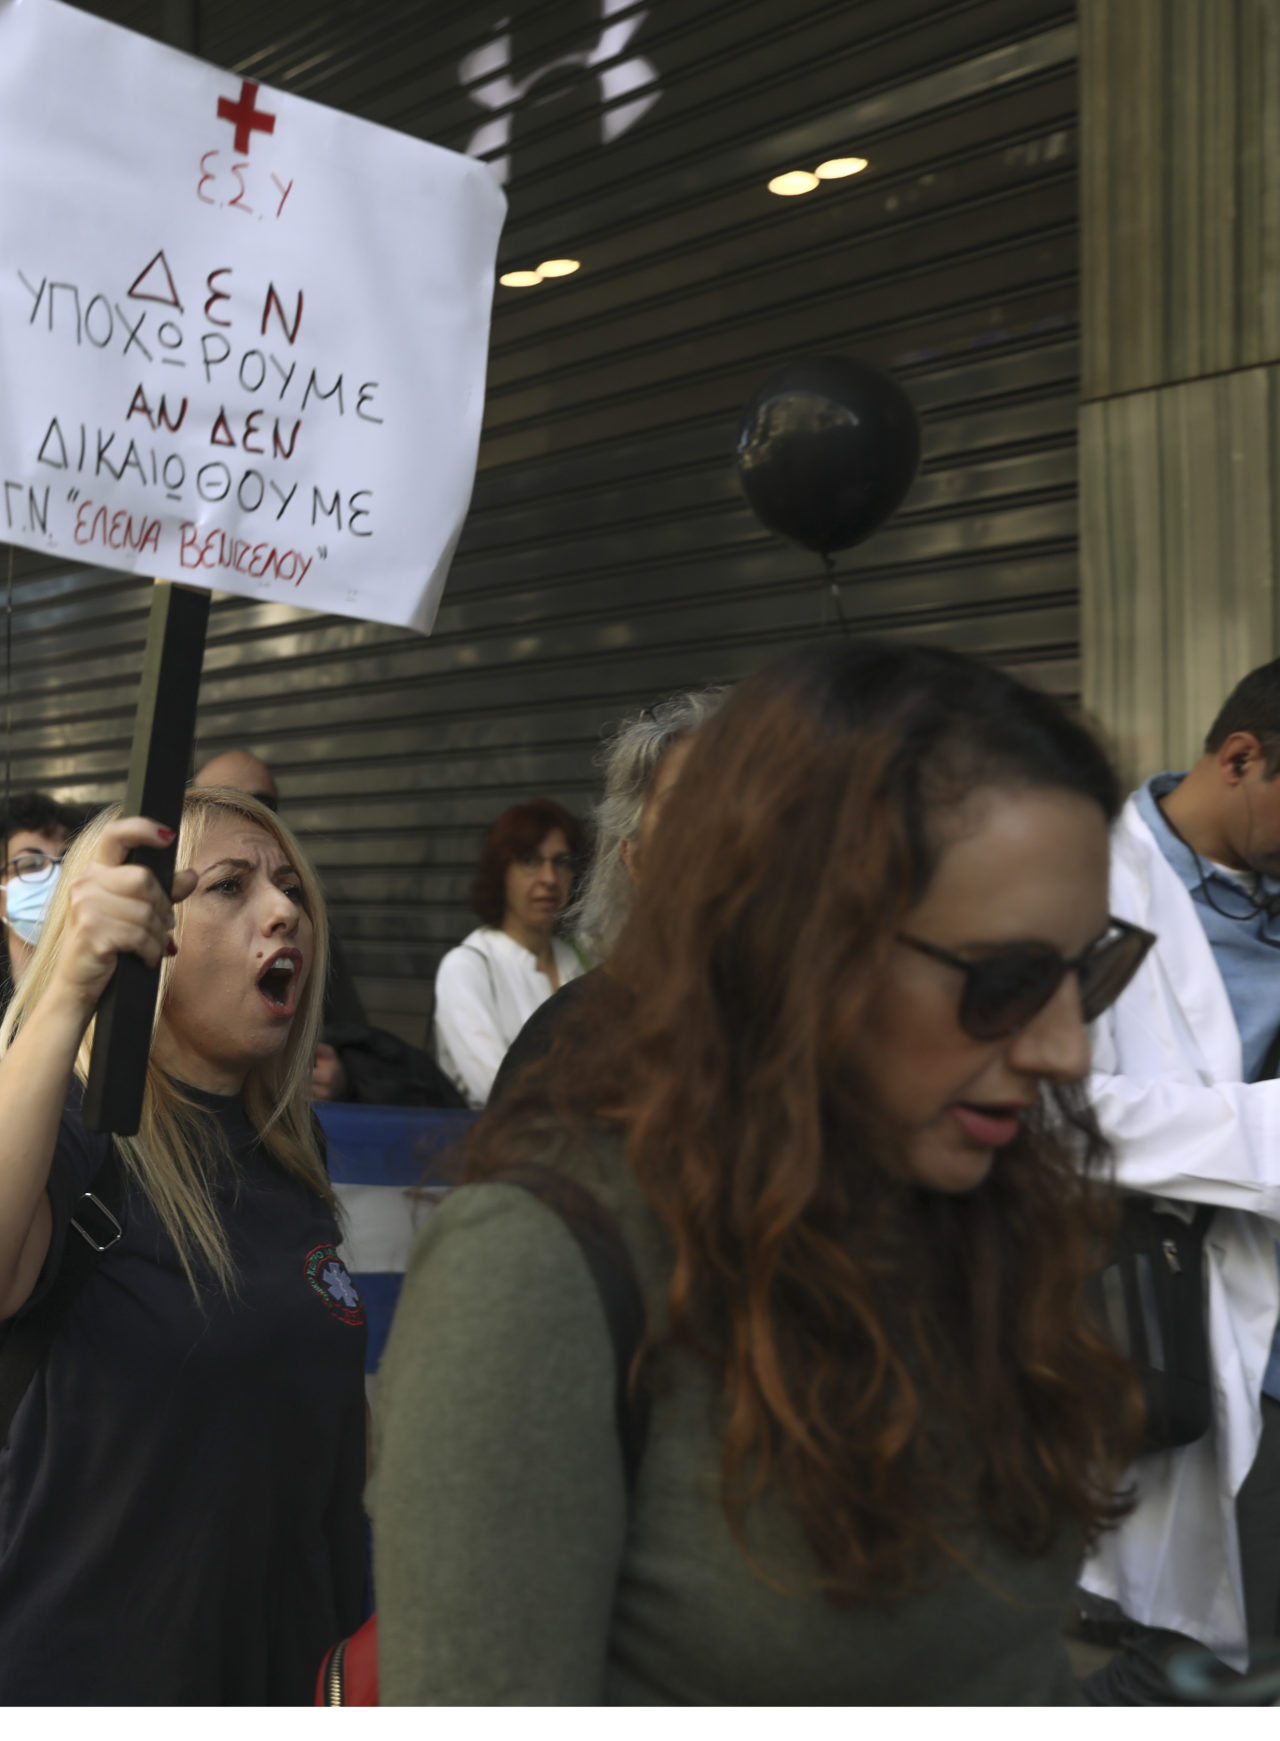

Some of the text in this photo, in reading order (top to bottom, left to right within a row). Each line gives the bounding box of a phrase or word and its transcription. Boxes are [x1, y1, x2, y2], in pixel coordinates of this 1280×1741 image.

[126, 249, 304, 346] ΔΕΝ
[125, 383, 302, 459] ΑΝ ΔΕΝ
